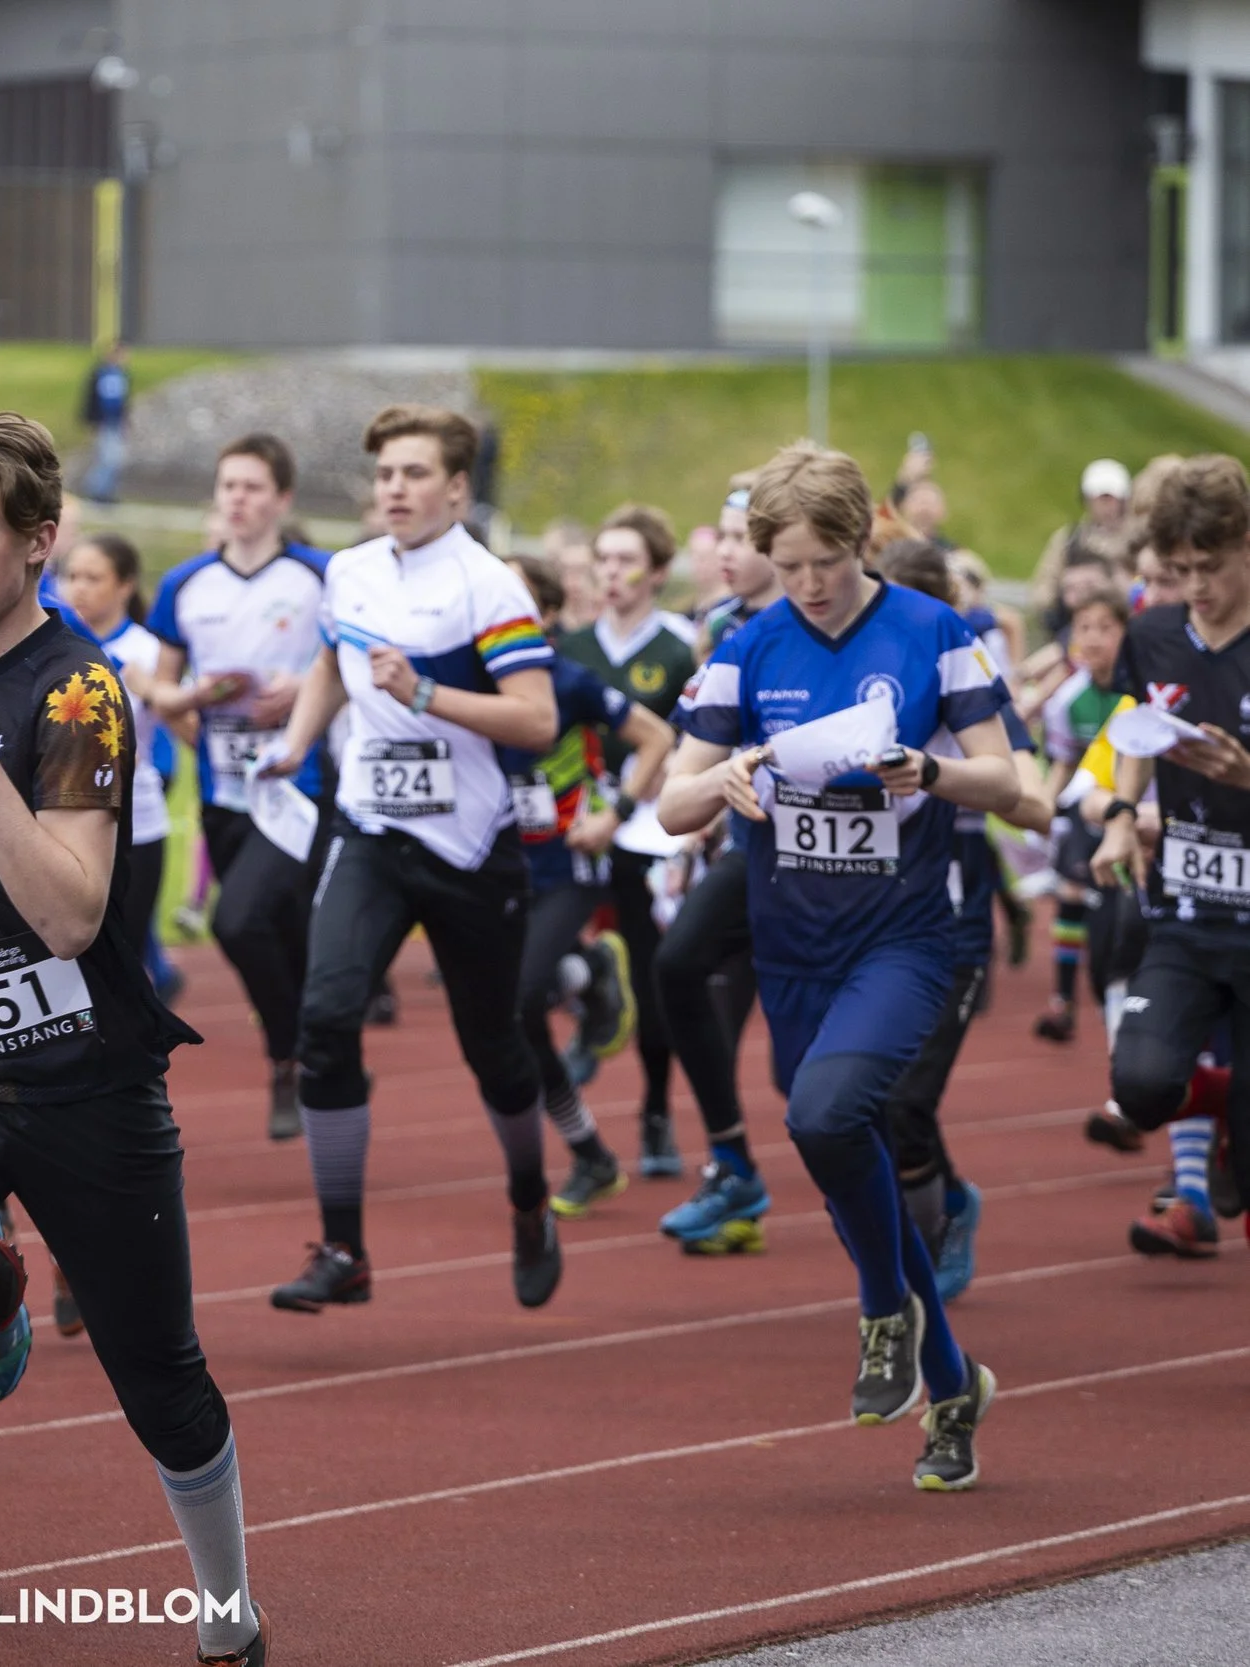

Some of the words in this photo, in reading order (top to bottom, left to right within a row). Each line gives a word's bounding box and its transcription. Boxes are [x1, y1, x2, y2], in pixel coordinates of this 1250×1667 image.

[372, 764, 432, 797] 824
[796, 812, 874, 854] 812
[799, 856, 880, 874] FINSPÅNG
[1183, 847, 1244, 887] 841
